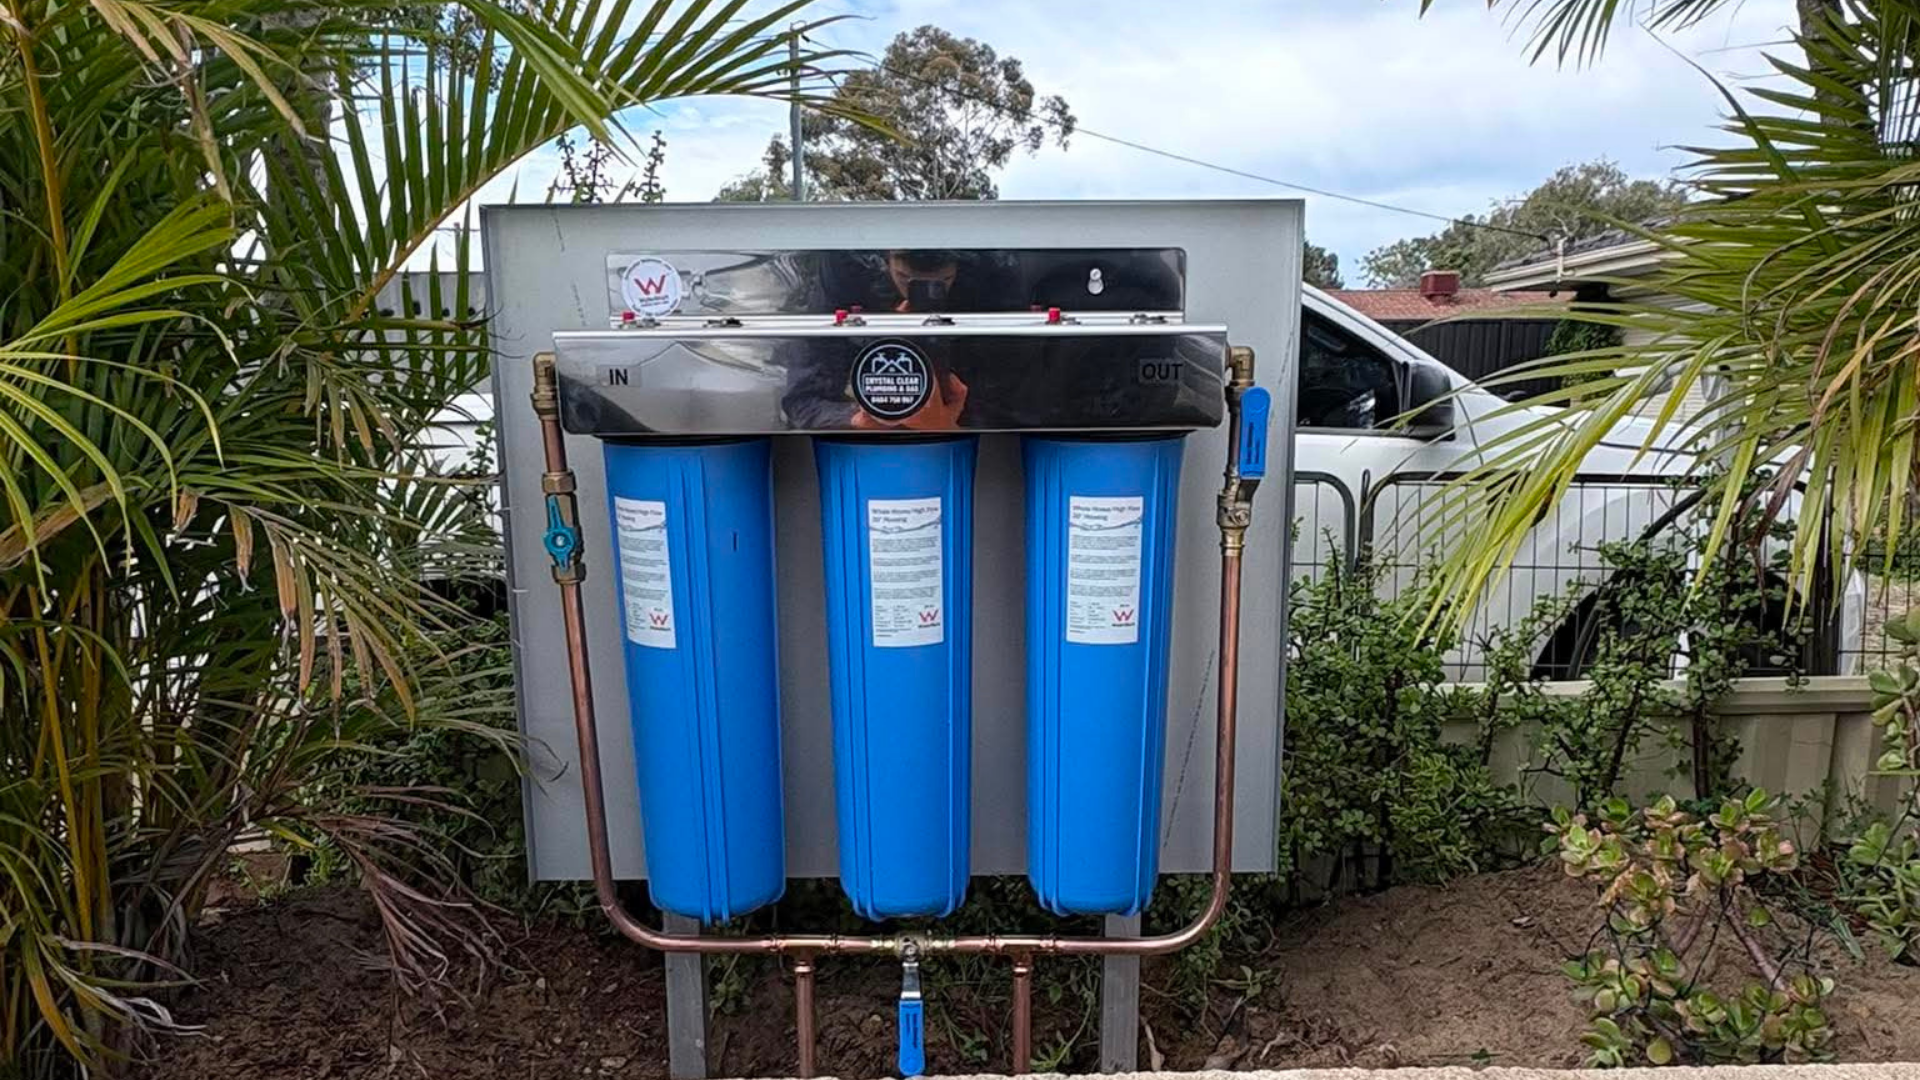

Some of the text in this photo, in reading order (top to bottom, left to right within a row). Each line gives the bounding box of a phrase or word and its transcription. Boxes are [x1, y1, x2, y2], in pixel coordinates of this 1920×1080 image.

[609, 368, 628, 386] IN
[1142, 363, 1183, 380] OUT
[865, 377, 920, 385] CRYSTAL CLEAR
